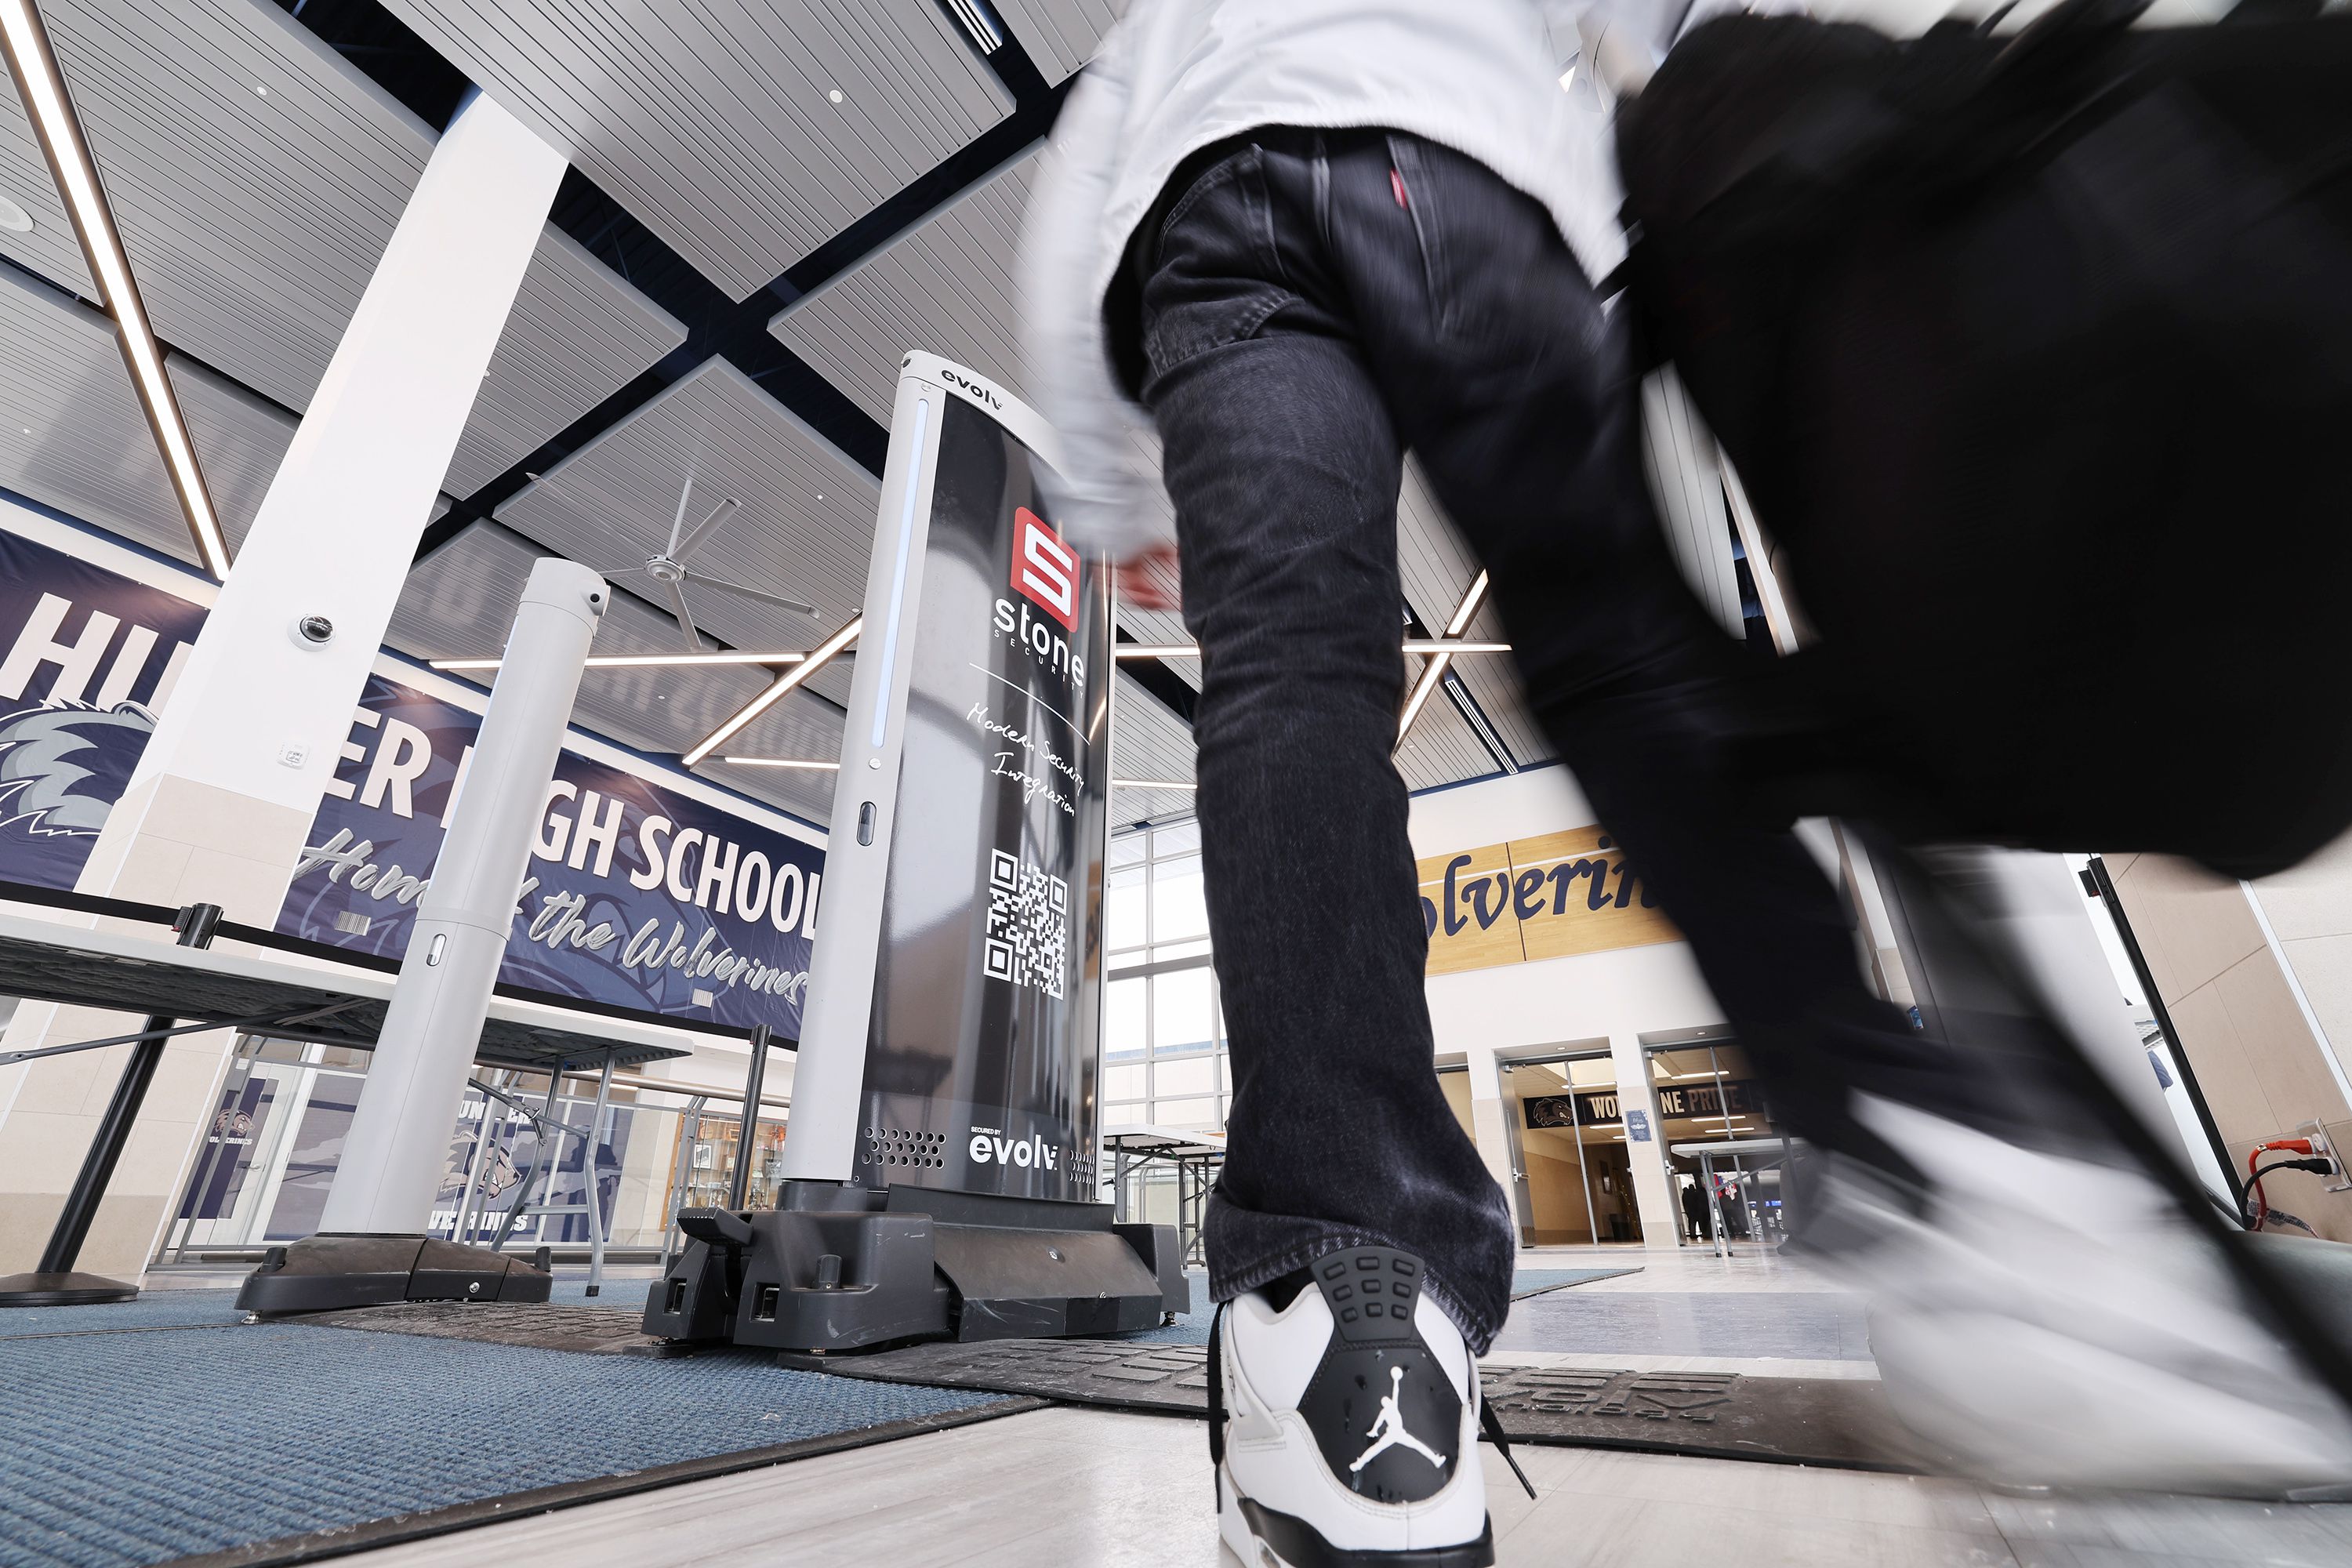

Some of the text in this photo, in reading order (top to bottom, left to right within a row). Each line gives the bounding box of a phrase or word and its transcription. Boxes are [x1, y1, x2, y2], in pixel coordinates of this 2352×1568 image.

[941, 369, 1004, 410] evolv
[993, 598, 1084, 687] stone
[994, 630, 1084, 699] SECURITY
[966, 702, 1085, 797] Modern Security
[990, 752, 1076, 817] Integration
[292, 828, 434, 907] Hom
[528, 890, 616, 950] the
[622, 918, 809, 1006] Wolverines
[629, 815, 821, 941] SCHOOL
[969, 1134, 1058, 1171] evolv
